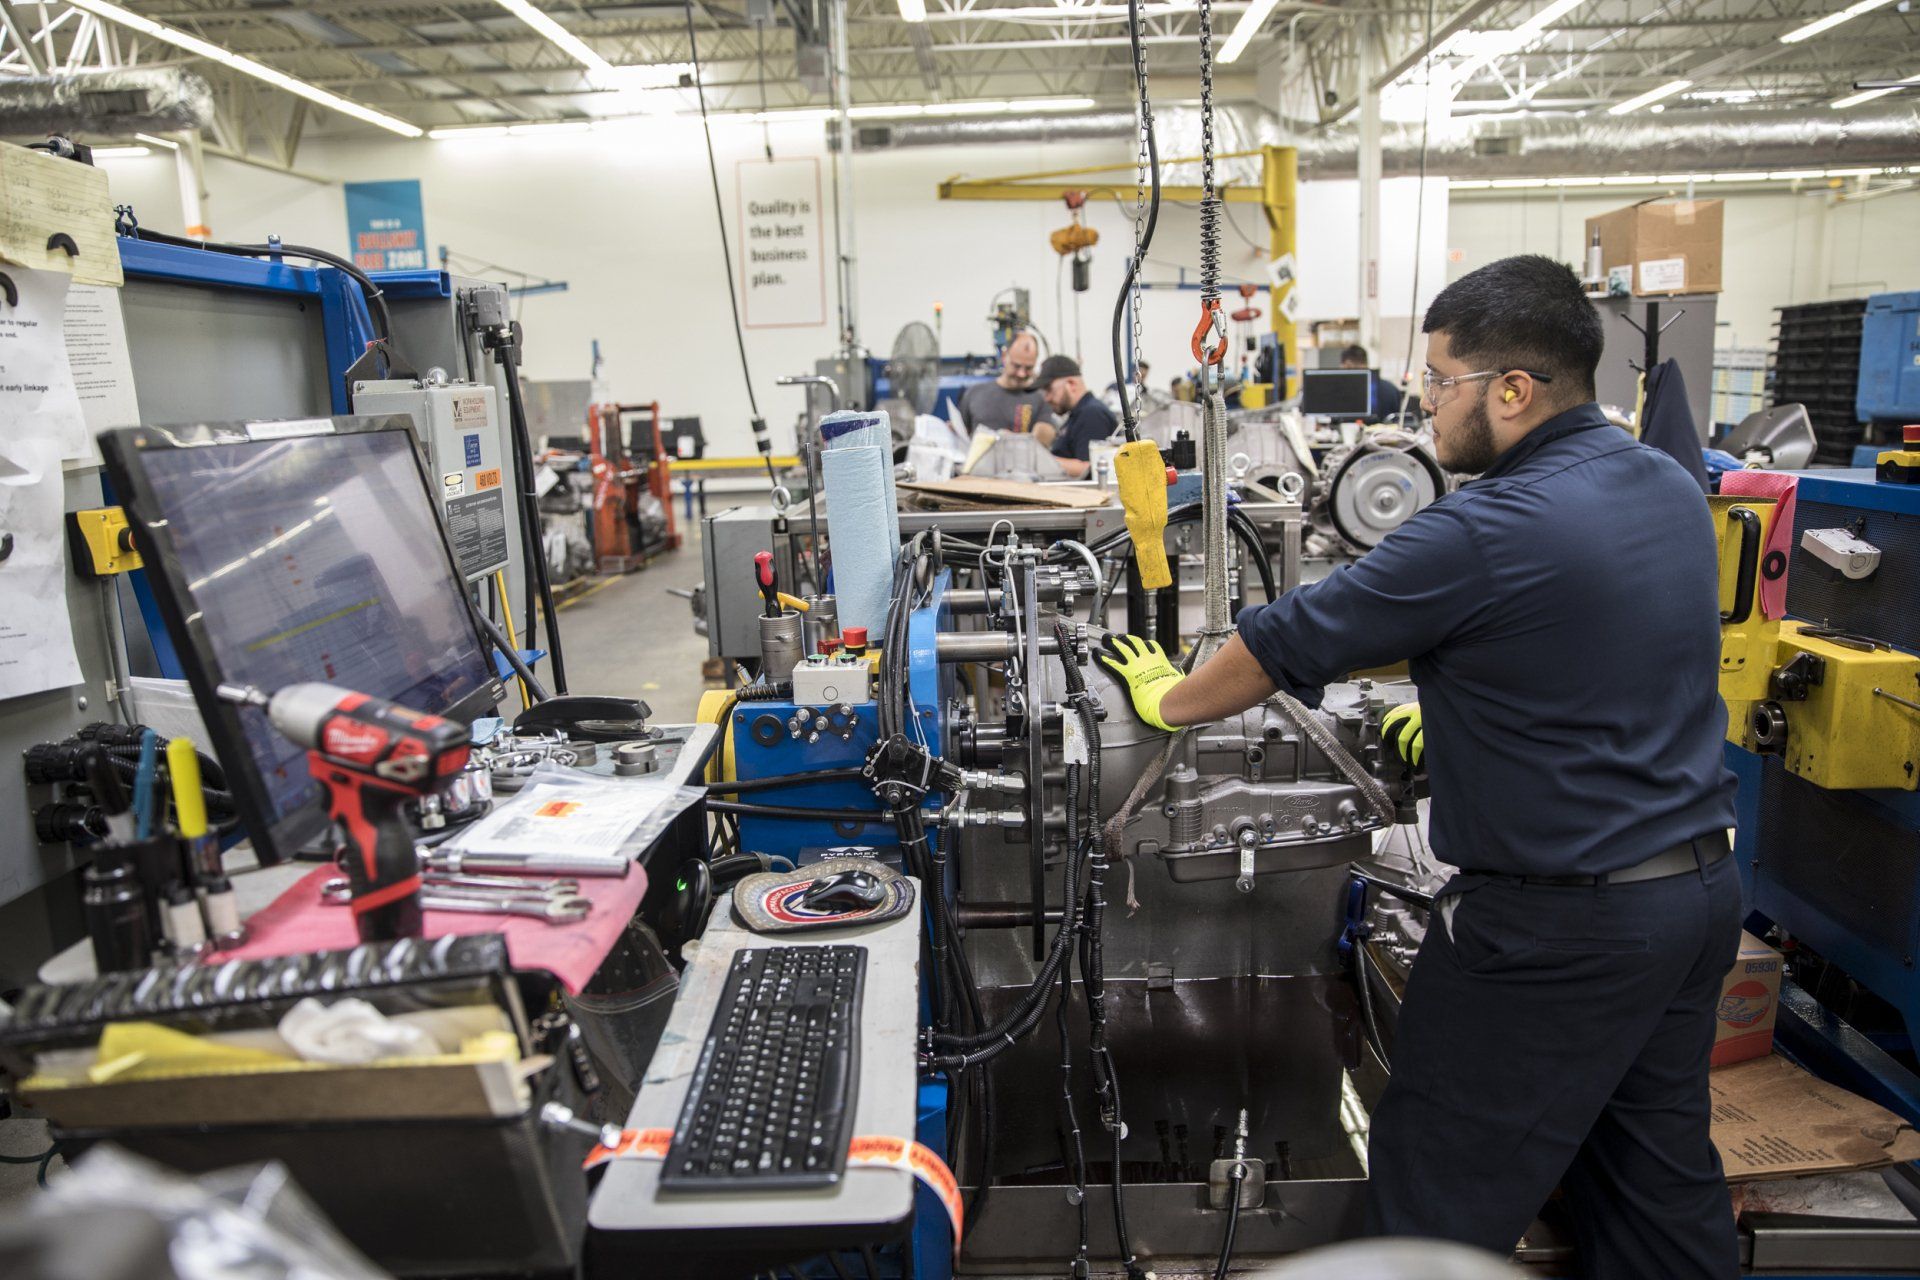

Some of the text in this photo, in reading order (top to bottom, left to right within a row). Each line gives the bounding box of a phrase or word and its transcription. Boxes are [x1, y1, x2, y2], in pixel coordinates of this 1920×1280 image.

[748, 199, 811, 217] Quality is
[750, 225, 804, 239] the best
[750, 249, 808, 263] business
[752, 272, 786, 290] plan.
[16, 320, 38, 328] regular
[5, 384, 22, 393] early
[23, 384, 49, 393] linkage
[1290, 796, 1313, 806] Ford
[1744, 960, 1778, 974] 05930
